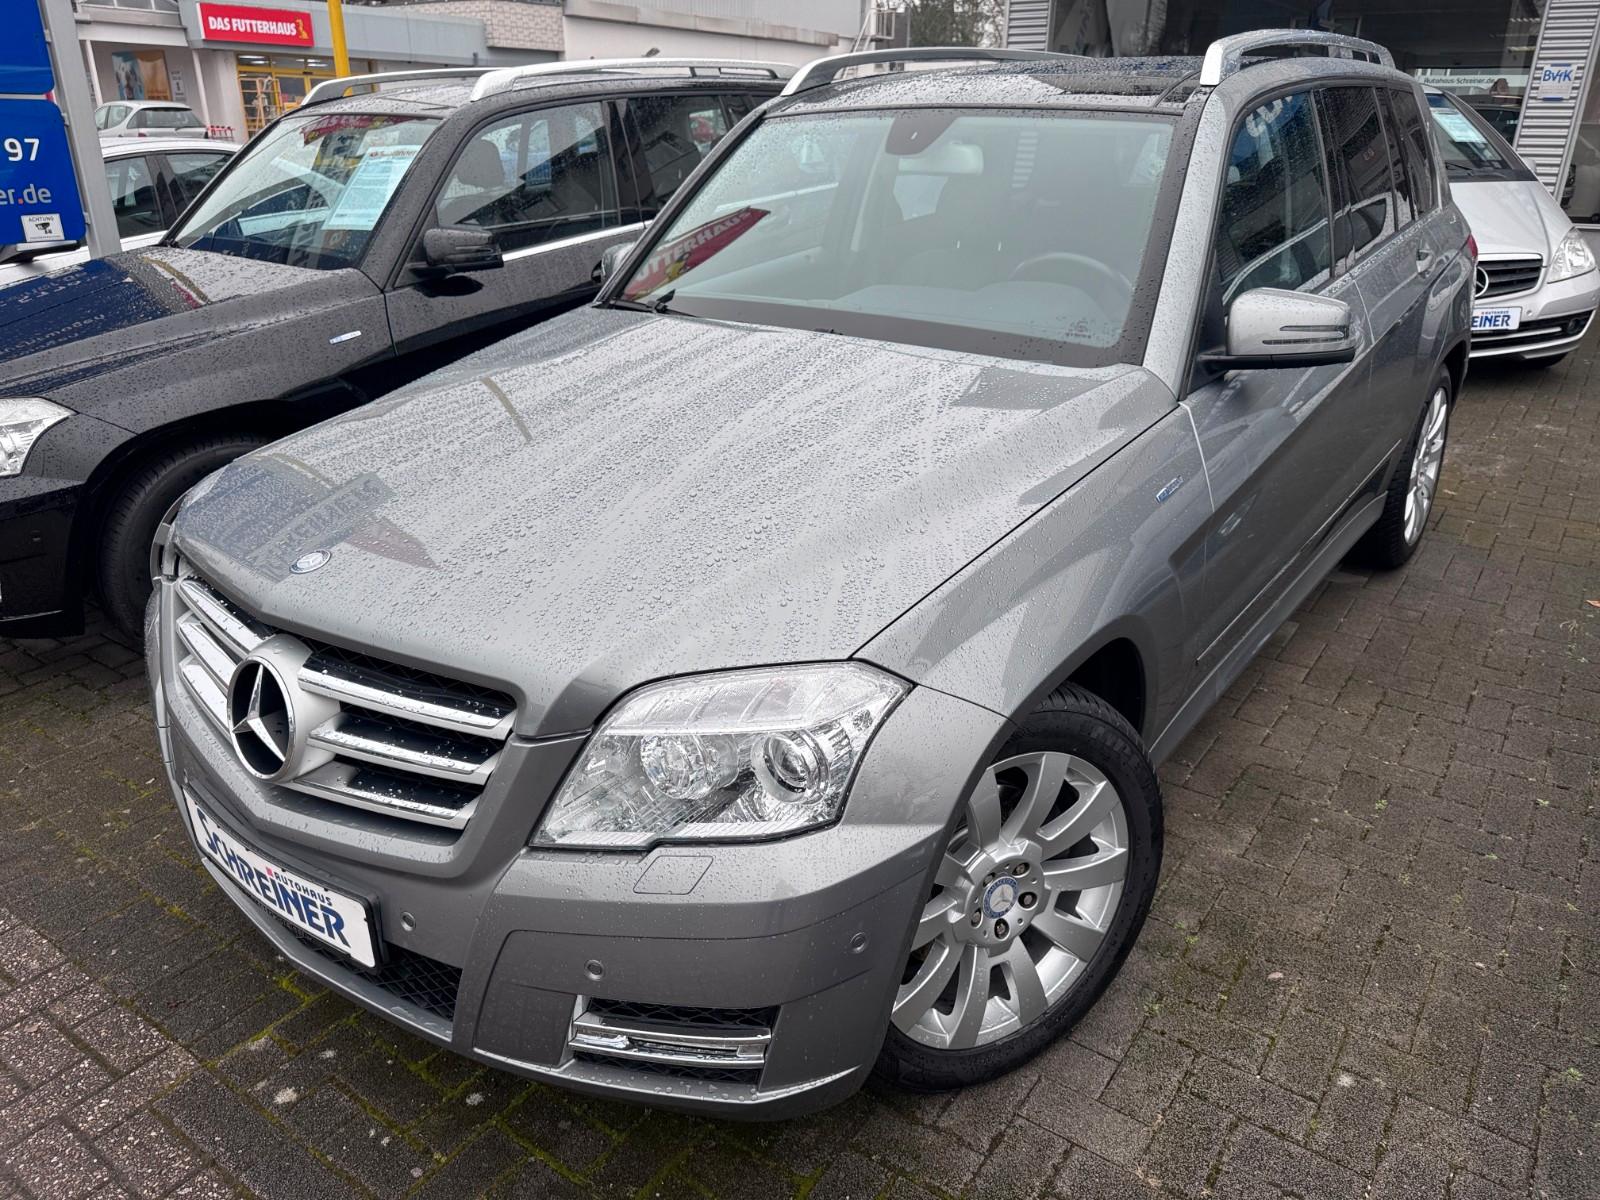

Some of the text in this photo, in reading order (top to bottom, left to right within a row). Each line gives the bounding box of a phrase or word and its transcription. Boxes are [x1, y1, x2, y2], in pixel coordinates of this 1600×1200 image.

[208, 15, 297, 36] DAS FUTTERHAUS
[3, 138, 40, 162] 97
[196, 807, 351, 948] SCHREINER
[273, 872, 333, 906] AUTOHAUS
